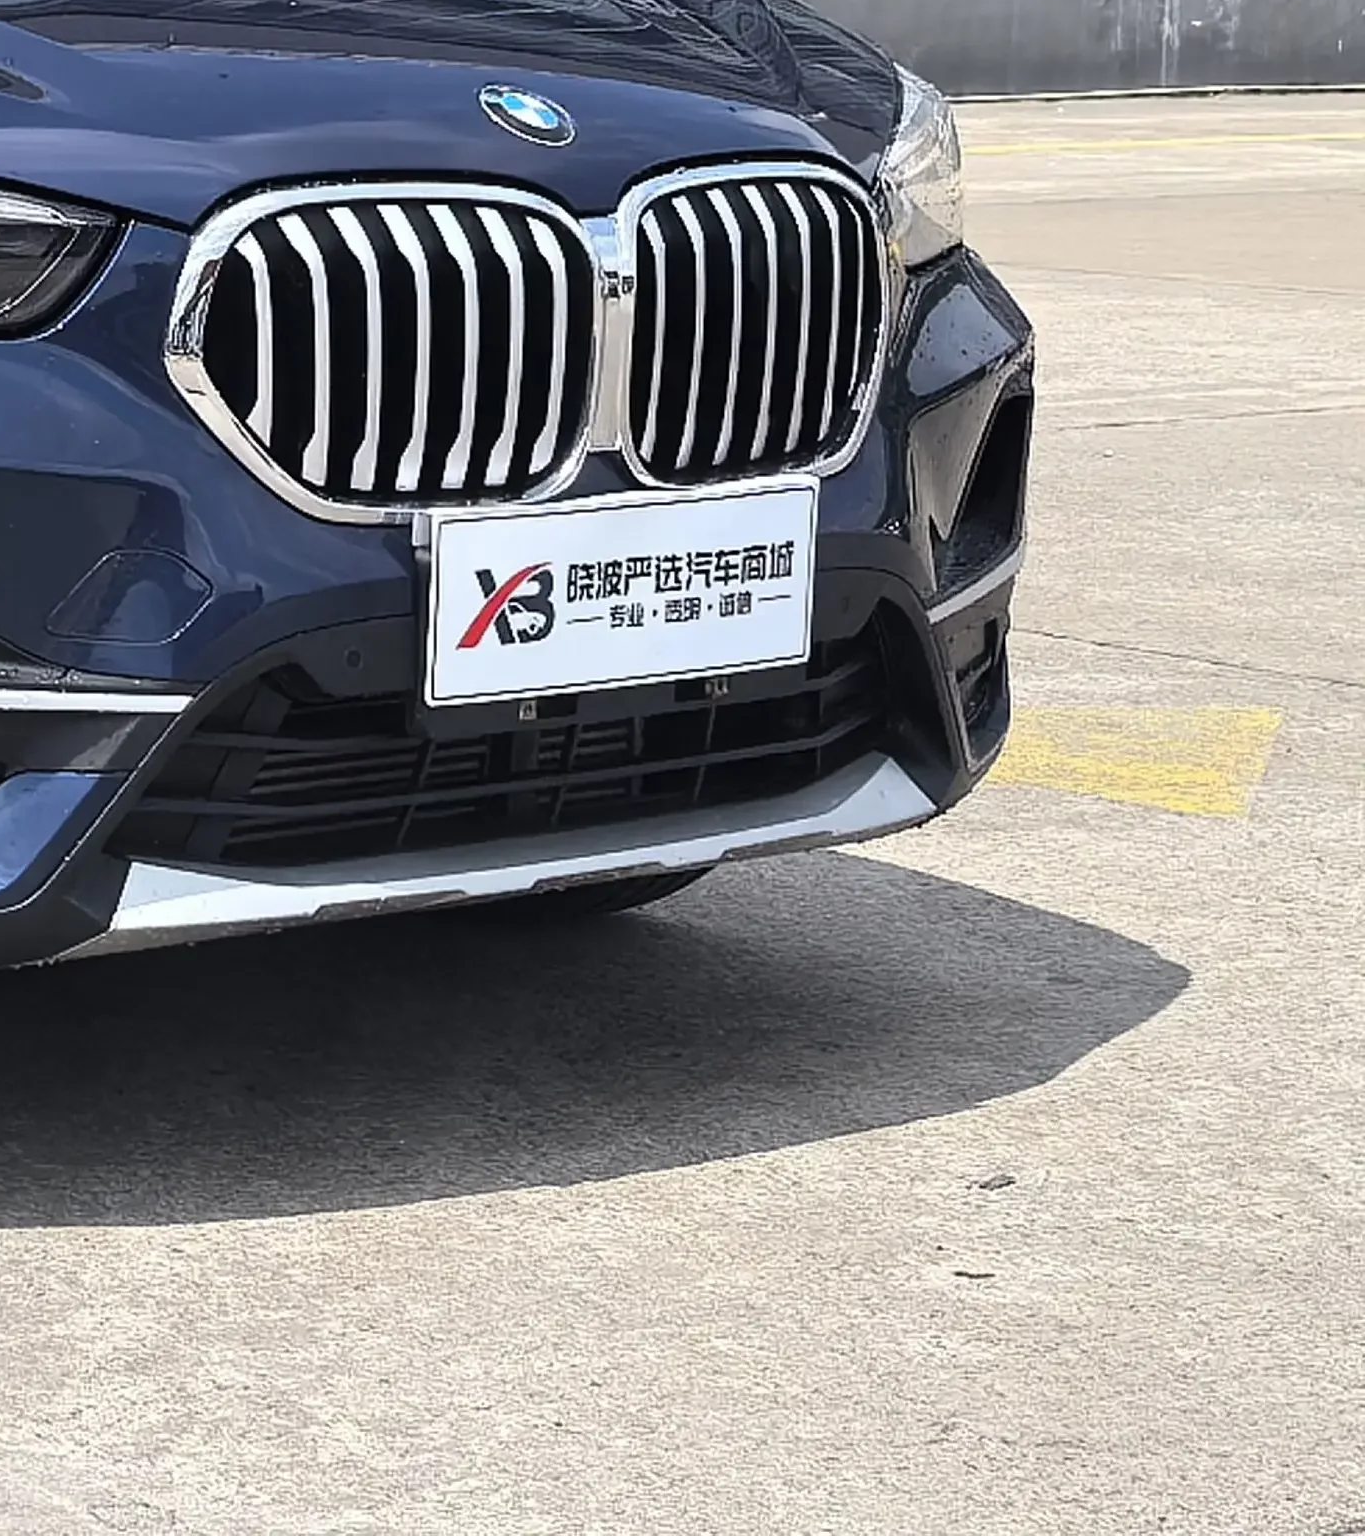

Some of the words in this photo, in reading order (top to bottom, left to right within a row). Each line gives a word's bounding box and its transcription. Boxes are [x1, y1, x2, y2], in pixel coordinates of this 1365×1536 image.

[566, 540, 794, 603] 晓波严选汽车商城
